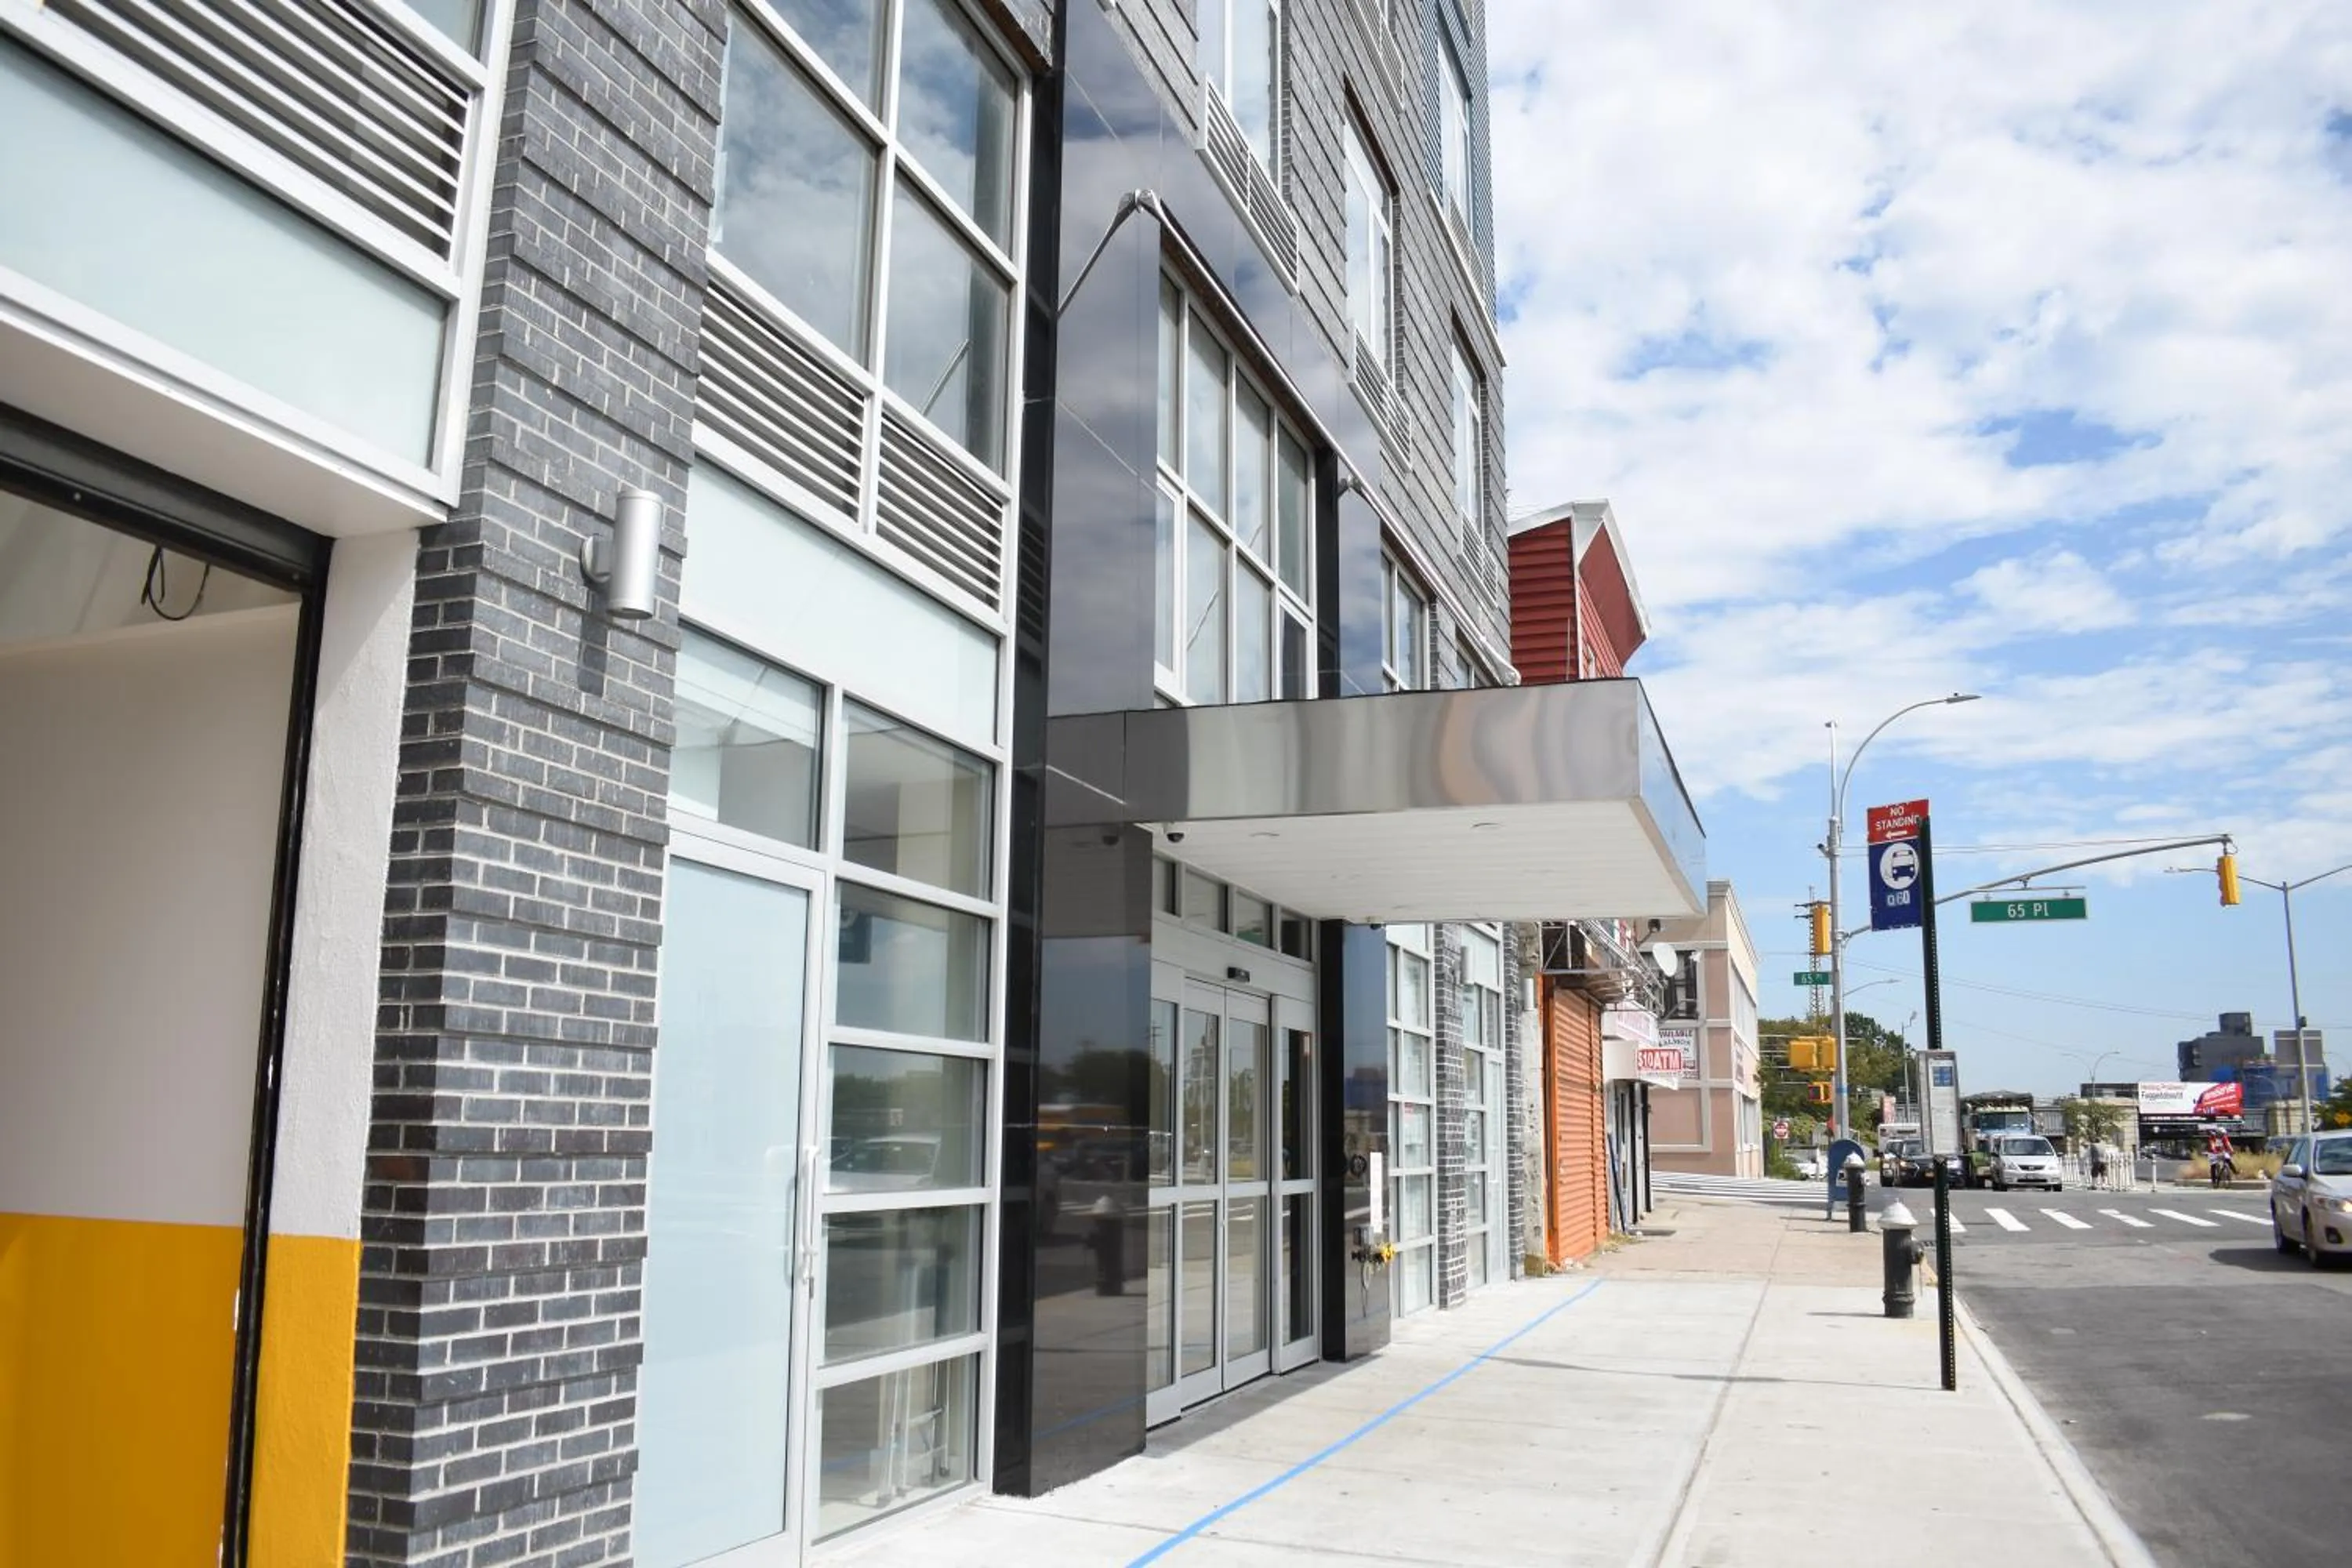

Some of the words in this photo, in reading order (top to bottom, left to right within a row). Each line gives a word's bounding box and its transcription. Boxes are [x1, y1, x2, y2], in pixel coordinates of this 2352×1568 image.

[1890, 806, 1905, 816] NO
[2008, 903, 2025, 918] 65
[2033, 902, 2049, 916] Pl
